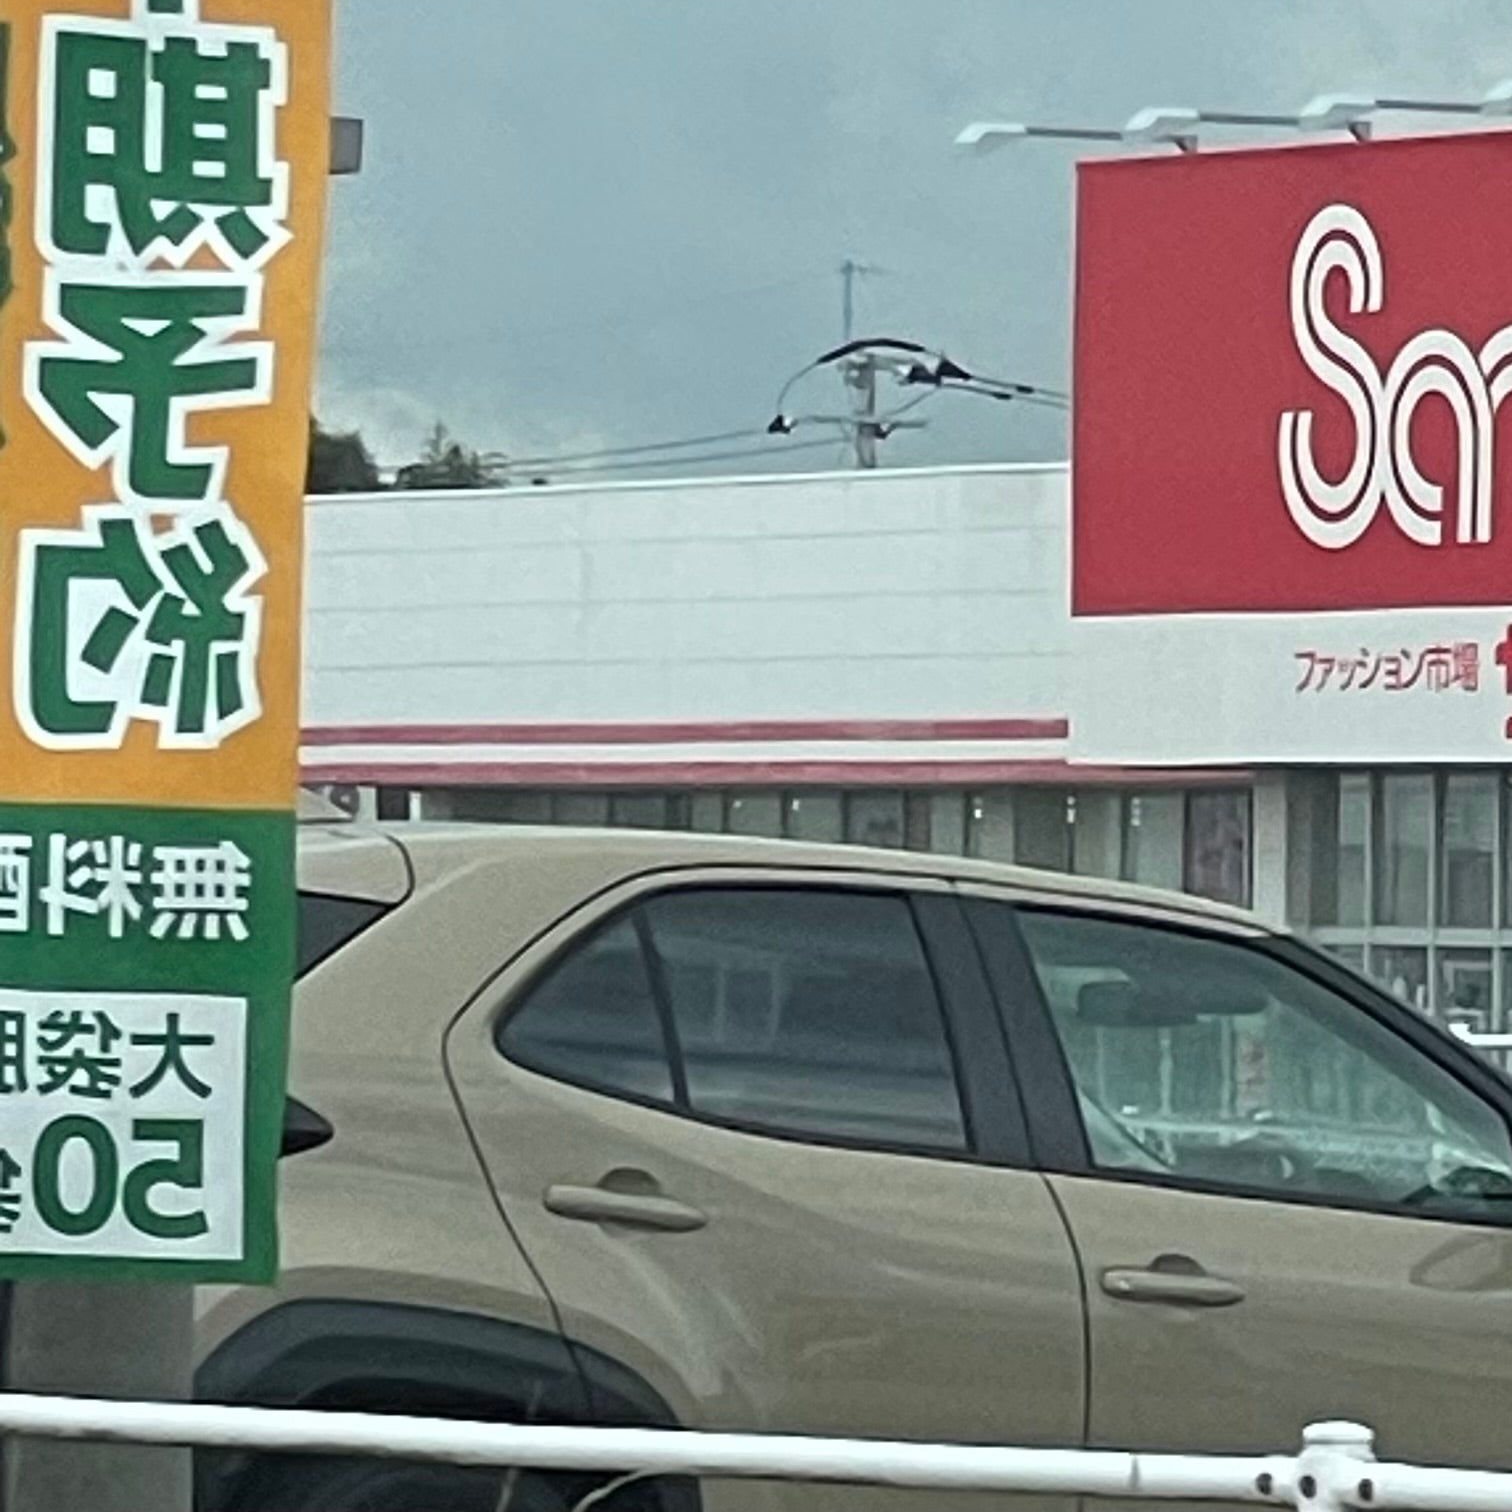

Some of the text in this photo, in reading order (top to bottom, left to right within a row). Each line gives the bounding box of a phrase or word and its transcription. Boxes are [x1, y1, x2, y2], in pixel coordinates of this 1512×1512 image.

[1294, 642, 1479, 693] ファッション市場
